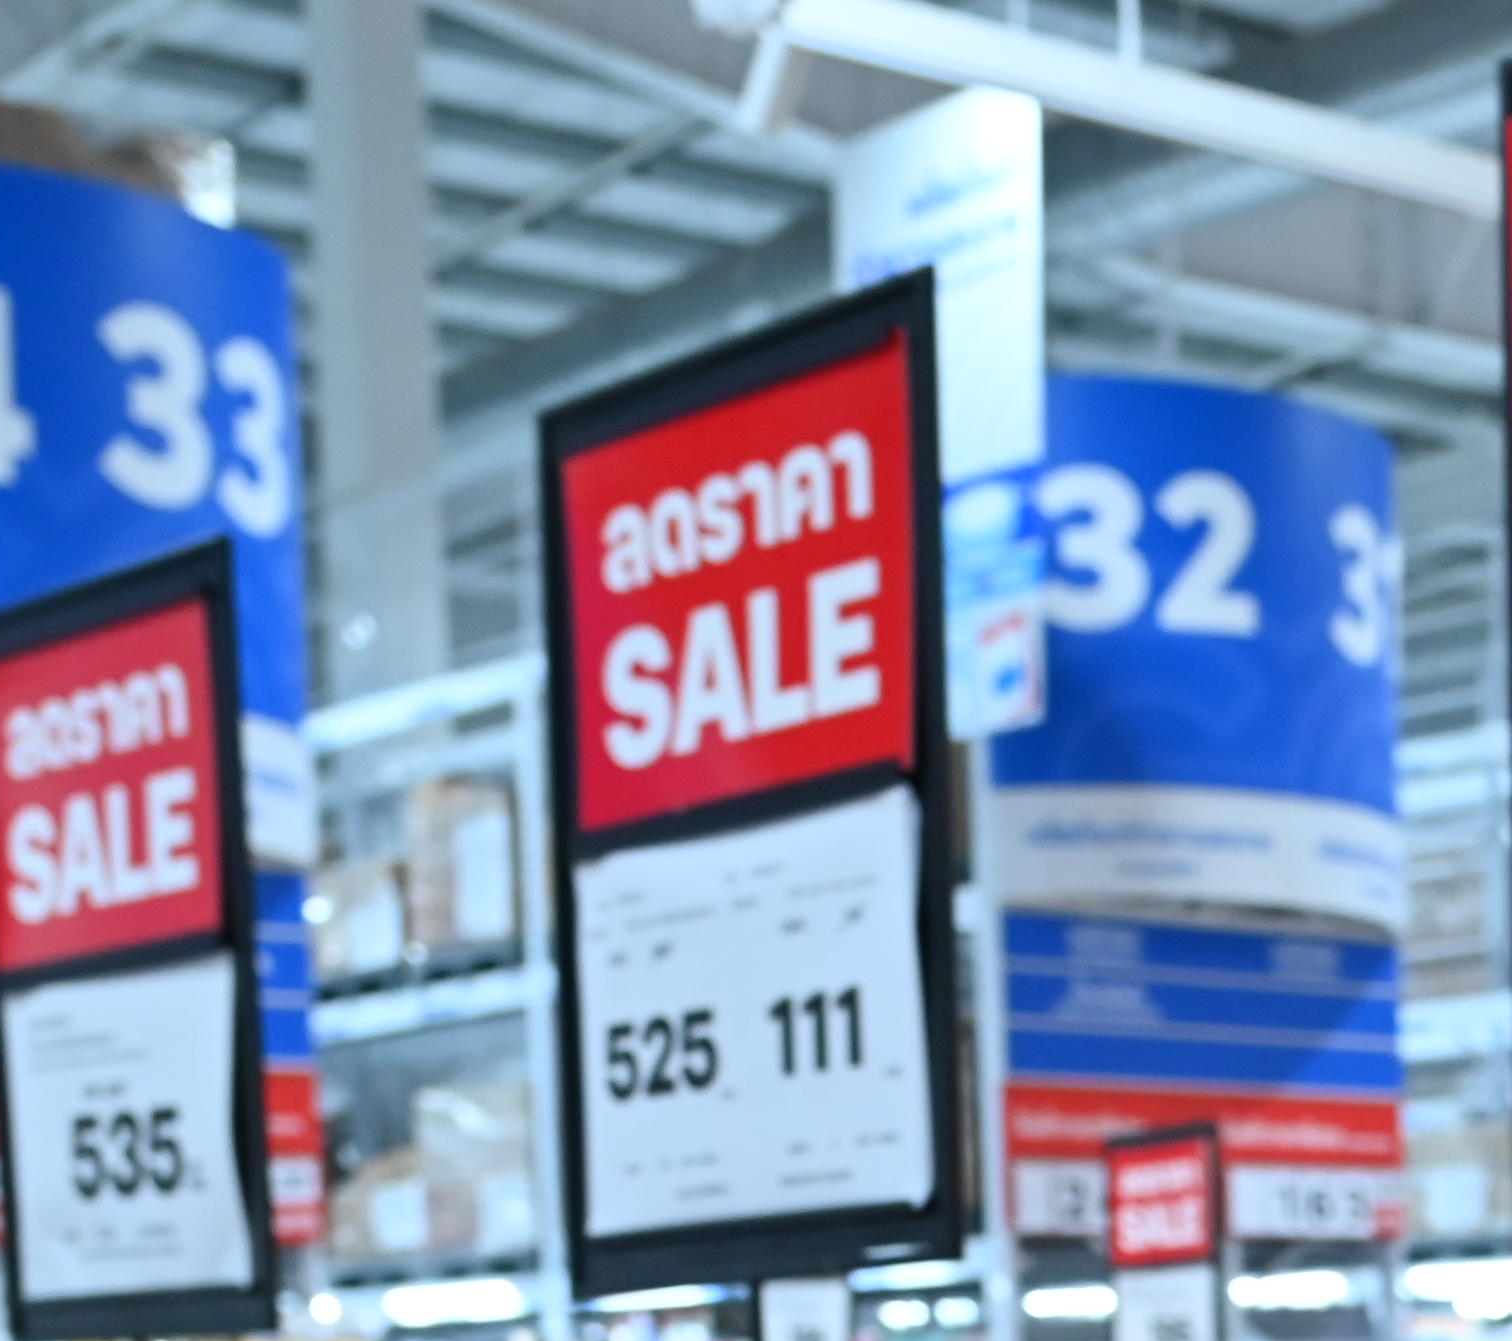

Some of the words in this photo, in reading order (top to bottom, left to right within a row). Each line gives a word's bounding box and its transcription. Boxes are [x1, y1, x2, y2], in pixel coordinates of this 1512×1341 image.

[95, 302, 290, 539] 33
[602, 430, 874, 594] ลดราคา
[1033, 463, 1261, 638] 32
[602, 557, 881, 770] SALE
[6, 767, 199, 924] SALE
[606, 1008, 718, 1102] 525
[768, 984, 864, 1076] 111
[70, 1105, 185, 1199] 535
